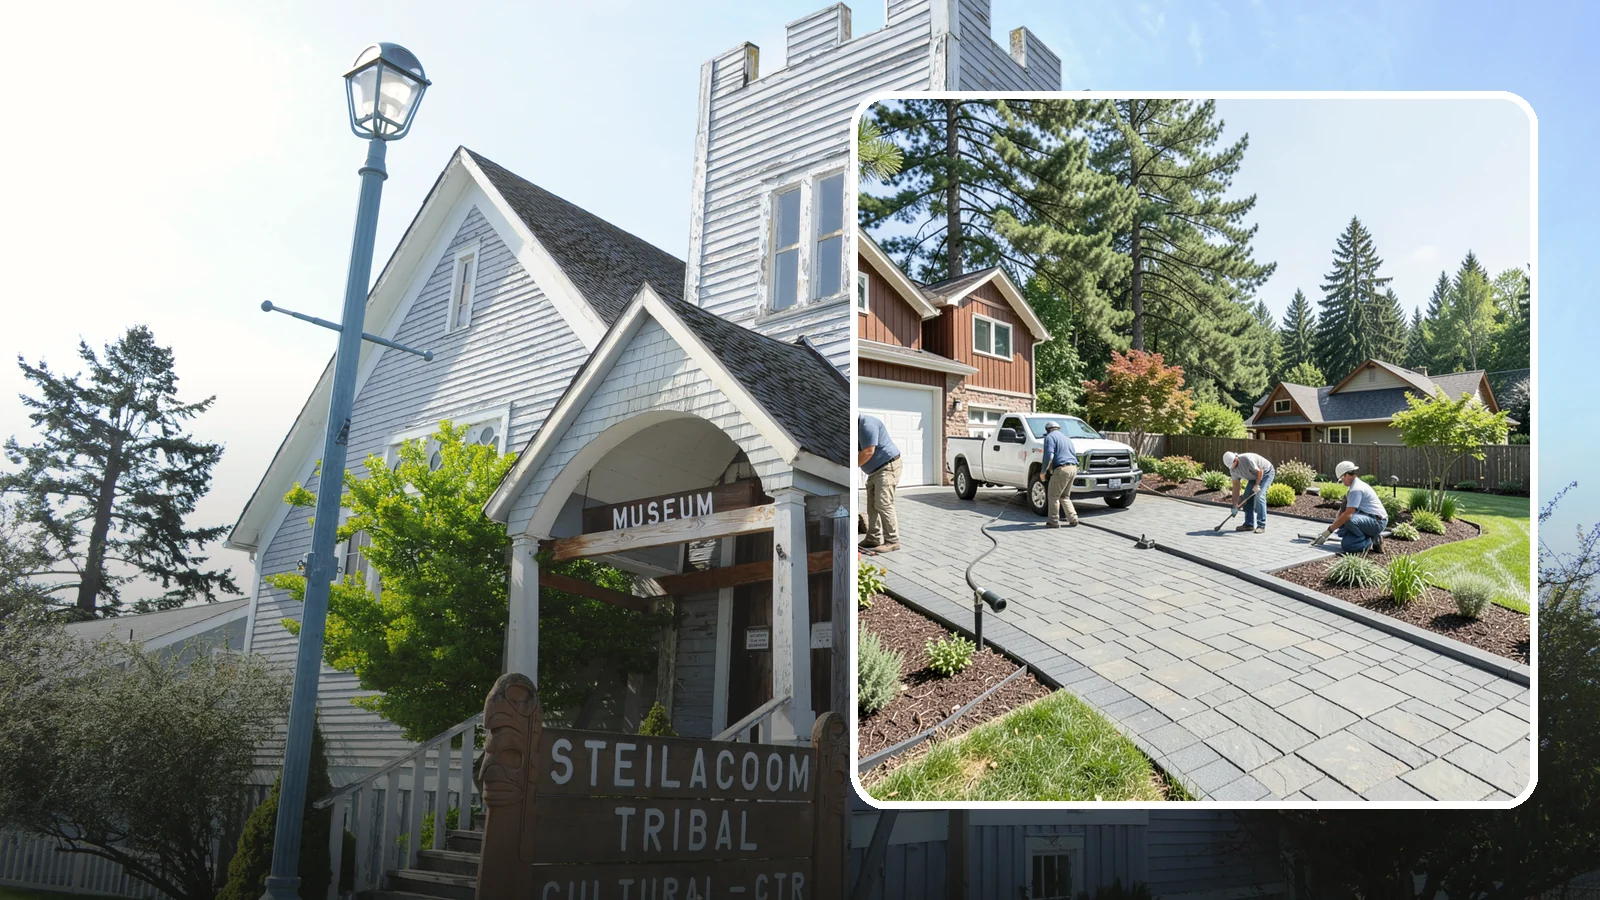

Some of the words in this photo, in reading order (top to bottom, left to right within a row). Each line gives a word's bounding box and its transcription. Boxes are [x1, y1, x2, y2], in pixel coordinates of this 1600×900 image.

[613, 491, 714, 531] MUSEUM
[550, 738, 809, 793] STEILACOOM
[614, 806, 758, 852] TRIBAL
[755, 871, 805, 900] CTR
